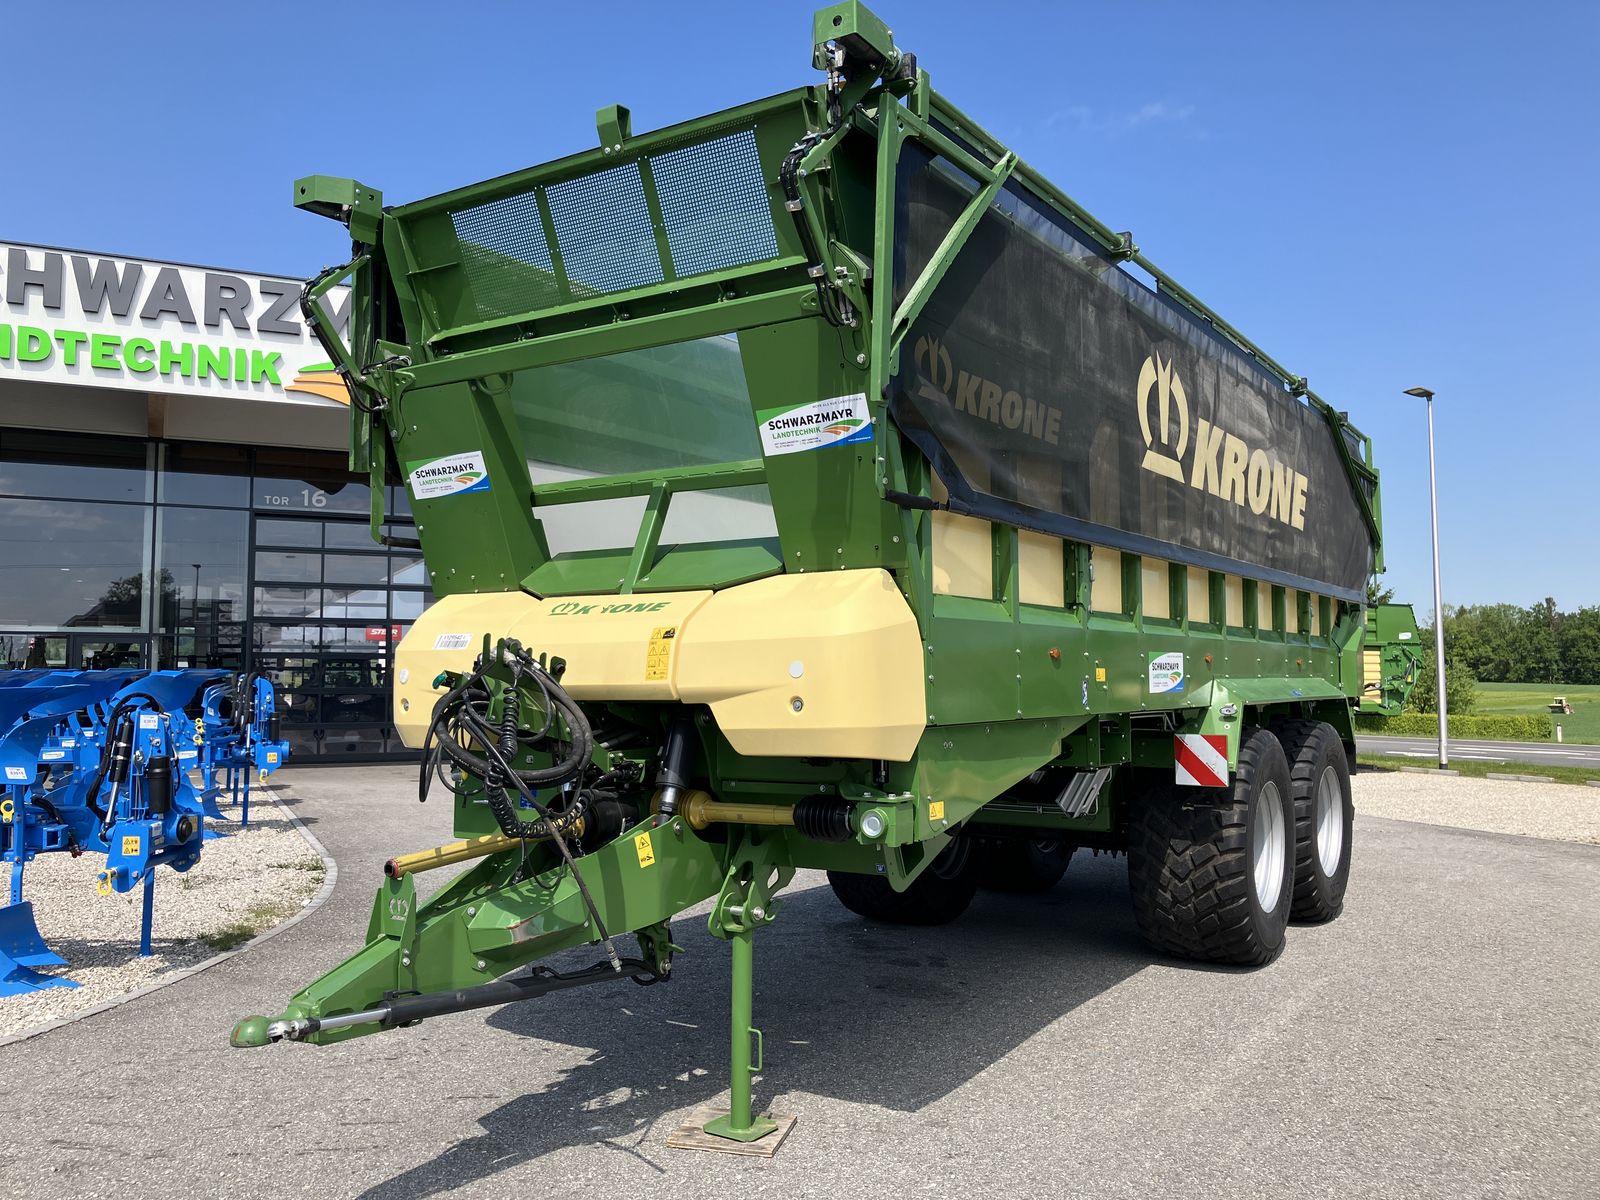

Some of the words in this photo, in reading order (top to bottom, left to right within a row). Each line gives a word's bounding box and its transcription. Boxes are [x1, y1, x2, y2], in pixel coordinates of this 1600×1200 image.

[955, 369, 1062, 445] KRONE
[768, 408, 853, 431] SCHWARZMAYR
[772, 426, 822, 440] LANDTECHNIK
[415, 463, 475, 479] SCHWARZMAYR
[1191, 417, 1308, 531] KRONE
[419, 476, 454, 487] LANDTECHNIK
[264, 495, 290, 506] TOR
[301, 489, 327, 508] 16
[370, 627, 399, 636] STER
